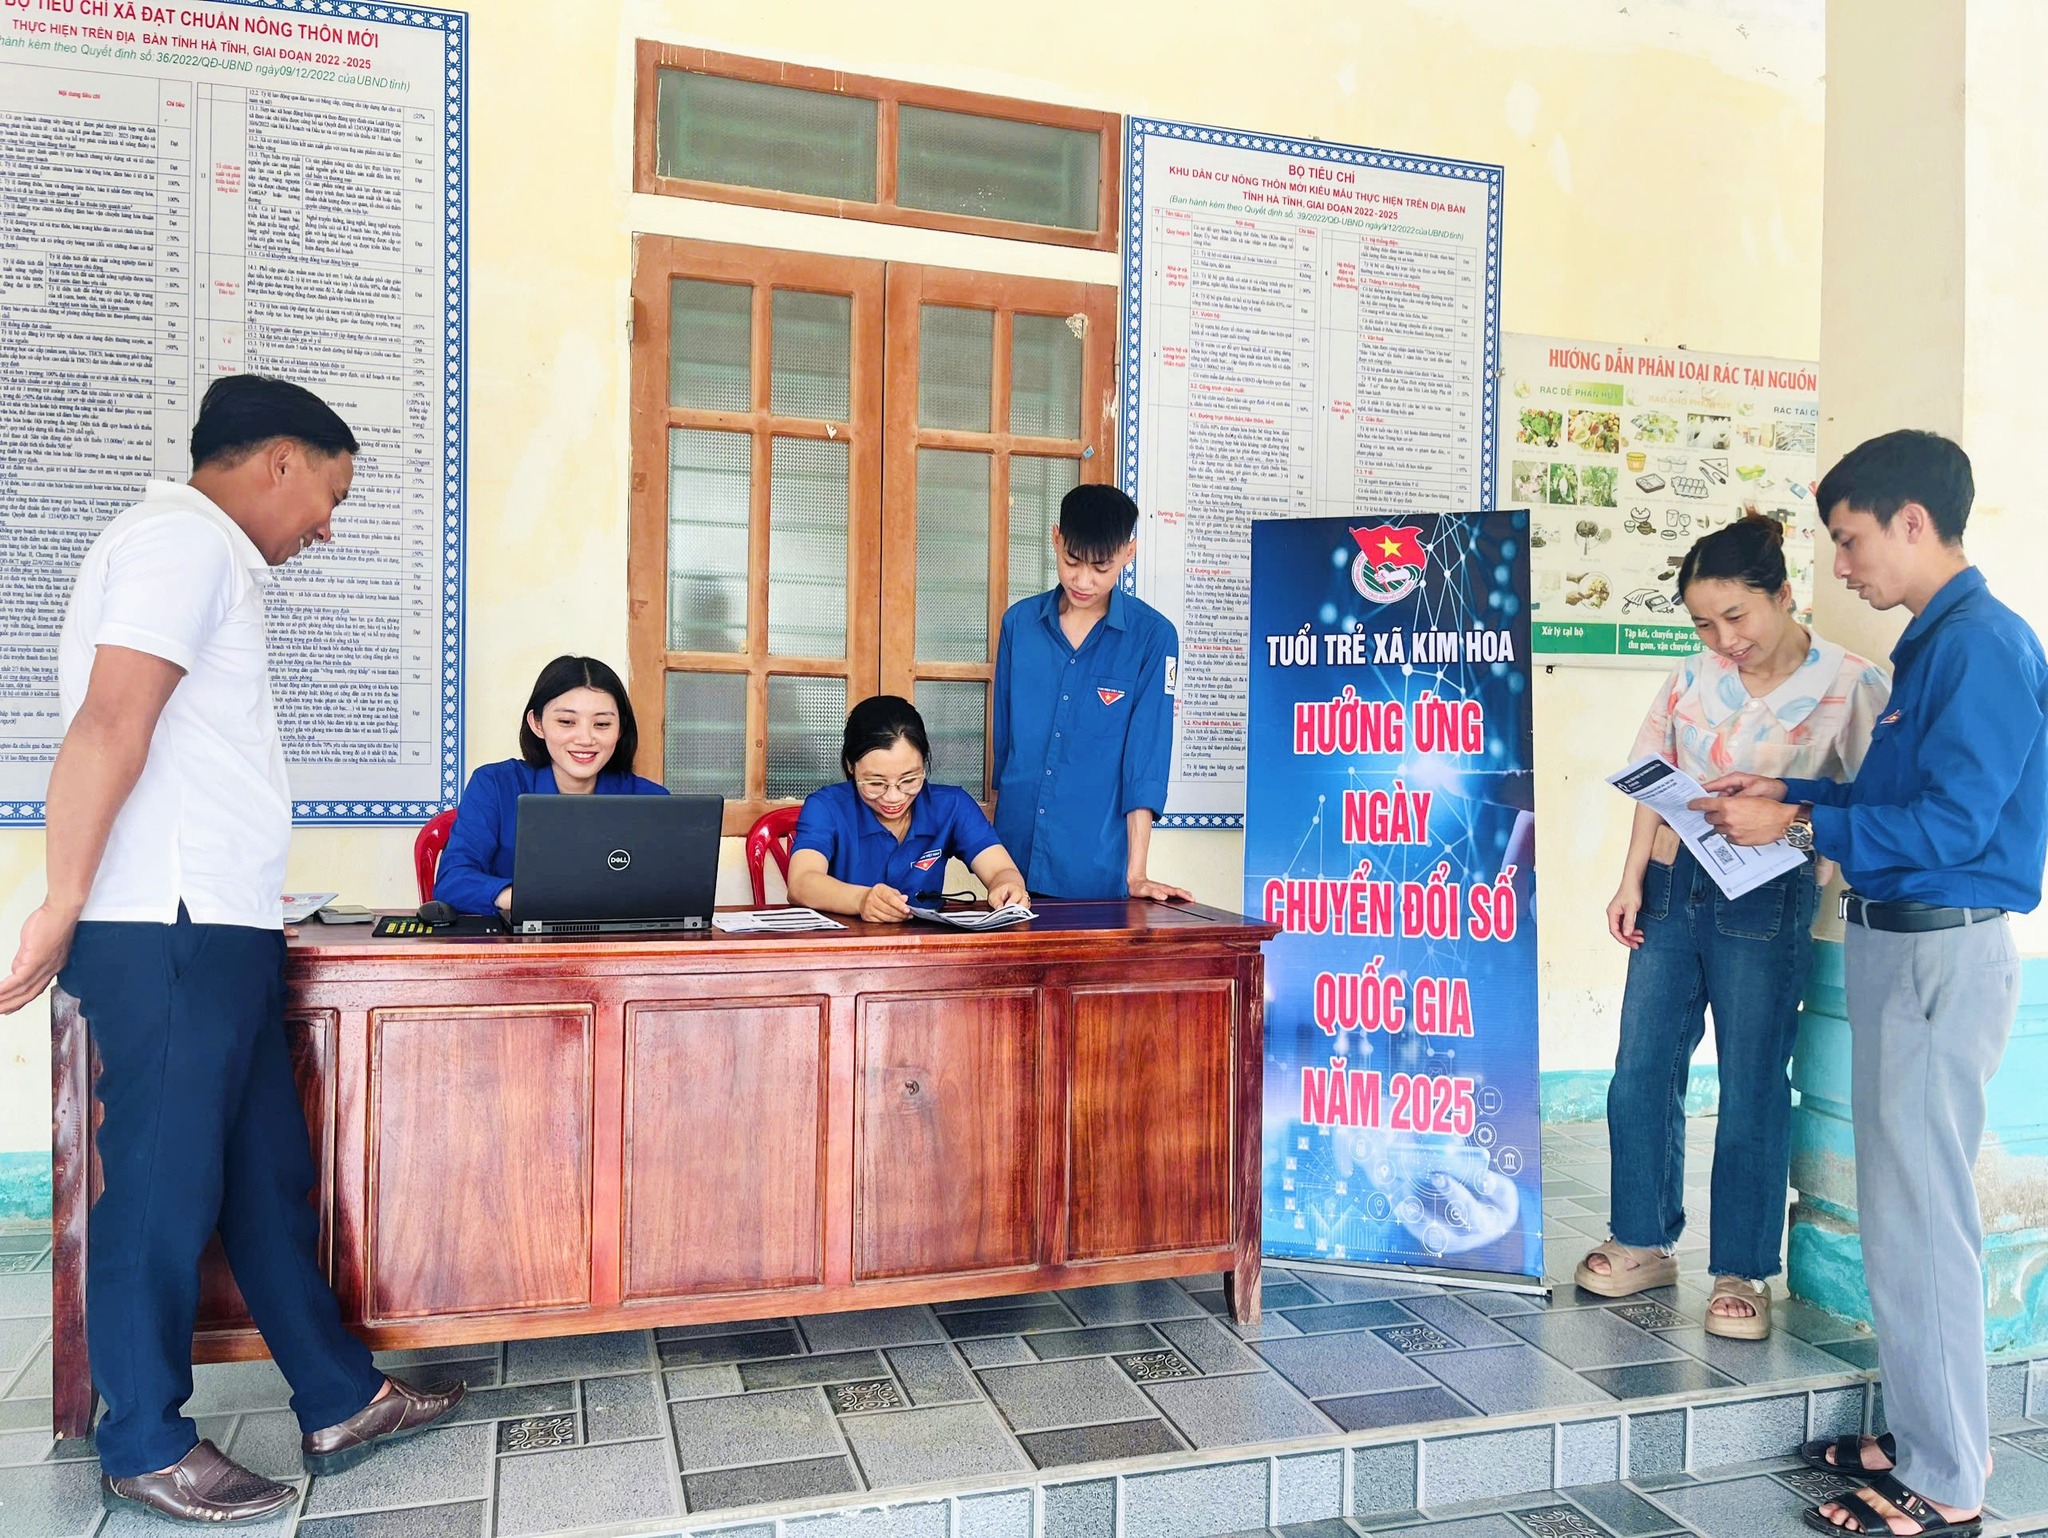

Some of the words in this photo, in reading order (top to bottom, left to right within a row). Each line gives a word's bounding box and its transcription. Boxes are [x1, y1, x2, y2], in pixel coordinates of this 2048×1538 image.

[12, 19, 46, 33] THỰC
[50, 24, 78, 36] HIỆN
[82, 26, 113, 40] TRÊN
[116, 32, 136, 46] ĐỊA
[143, 33, 168, 46] BÀN
[172, 35, 198, 49] TỈNH
[201, 40, 217, 50] HÀ
[221, 41, 249, 56] TĨNH,
[253, 46, 276, 58] GIAI
[280, 49, 312, 64] ĐOẠN
[315, 53, 340, 66] 2022
[80, 0, 108, 16] CHÍ
[114, 2, 136, 20] XÃ
[141, 6, 176, 26] ĐẠT
[180, 11, 239, 32] CHUẨN
[244, 16, 292, 37] NÔNG
[298, 24, 342, 44] THÔN
[348, 28, 378, 48] MỚI
[28, 38, 50, 50] kèm
[54, 42, 76, 54] theo
[80, 44, 112, 58] Quyết
[114, 46, 136, 60] định
[156, 52, 252, 72] 36/2022/QĐ-UBND
[1169, 166, 1189, 176] KHU
[1192, 169, 1212, 180] DÂN
[1215, 172, 1230, 181] CƯ
[1232, 174, 1258, 186] NÔNG
[1261, 178, 1286, 190] THÔN
[1289, 181, 1307, 192] MỚI
[1309, 184, 1330, 196] KIỂU
[1333, 187, 1352, 199] MẪU
[1356, 192, 1380, 203] THỰC
[1382, 194, 1403, 207] HIỆN
[1406, 198, 1428, 209] TRÊN
[1431, 201, 1445, 212] ĐỊA
[1448, 203, 1466, 214] BÀN
[1289, 165, 1305, 178] BỘ
[1309, 167, 1333, 180] TIÊU
[1337, 171, 1355, 184] CHÍ
[1169, 195, 1186, 205] (Ban
[1188, 197, 1207, 207] hành
[1210, 200, 1225, 209] kèm
[1227, 202, 1243, 212] theo
[1245, 204, 1266, 215] Quyết
[1267, 207, 1283, 217] định
[1242, 190, 1264, 202] TỈNH
[1266, 193, 1279, 204] HÀ
[1307, 200, 1324, 210] GIAI
[1327, 203, 1352, 215] ĐOẠN
[1549, 347, 1600, 371] HƯỚNG
[1605, 348, 1634, 375] DẪN
[1638, 355, 1675, 378] PHÂN
[1678, 362, 1709, 384] LOẠI
[1713, 361, 1740, 384] RÁC
[1744, 368, 1764, 390] TẠI
[1768, 367, 1817, 392] NGUỒN
[1266, 623, 1317, 666] TUỔI
[1324, 624, 1367, 665] TRẺ
[1373, 626, 1405, 664] XÃ
[1412, 630, 1458, 663] KIM
[1465, 630, 1515, 663] HOA
[1542, 625, 1553, 636] Xử
[1554, 626, 1561, 637] lý
[1574, 627, 1584, 637] hộ
[1625, 628, 1636, 639] Tập
[1675, 631, 1688, 641] giao
[1628, 640, 1639, 649] thu
[1640, 643, 1656, 651] gom,
[1294, 685, 1404, 755] HƯỞNG
[1413, 690, 1484, 754] ỨNG
[1343, 780, 1432, 844] NGÀY
[1263, 859, 1393, 937] CHUYỂN
[1401, 861, 1460, 940] ĐỔI
[1468, 865, 1518, 942] SỐ
[1314, 956, 1405, 1035] QUỐC
[1414, 976, 1474, 1037] GIA
[1301, 1056, 1382, 1130] NĂM
[1390, 1072, 1476, 1136] 2025
